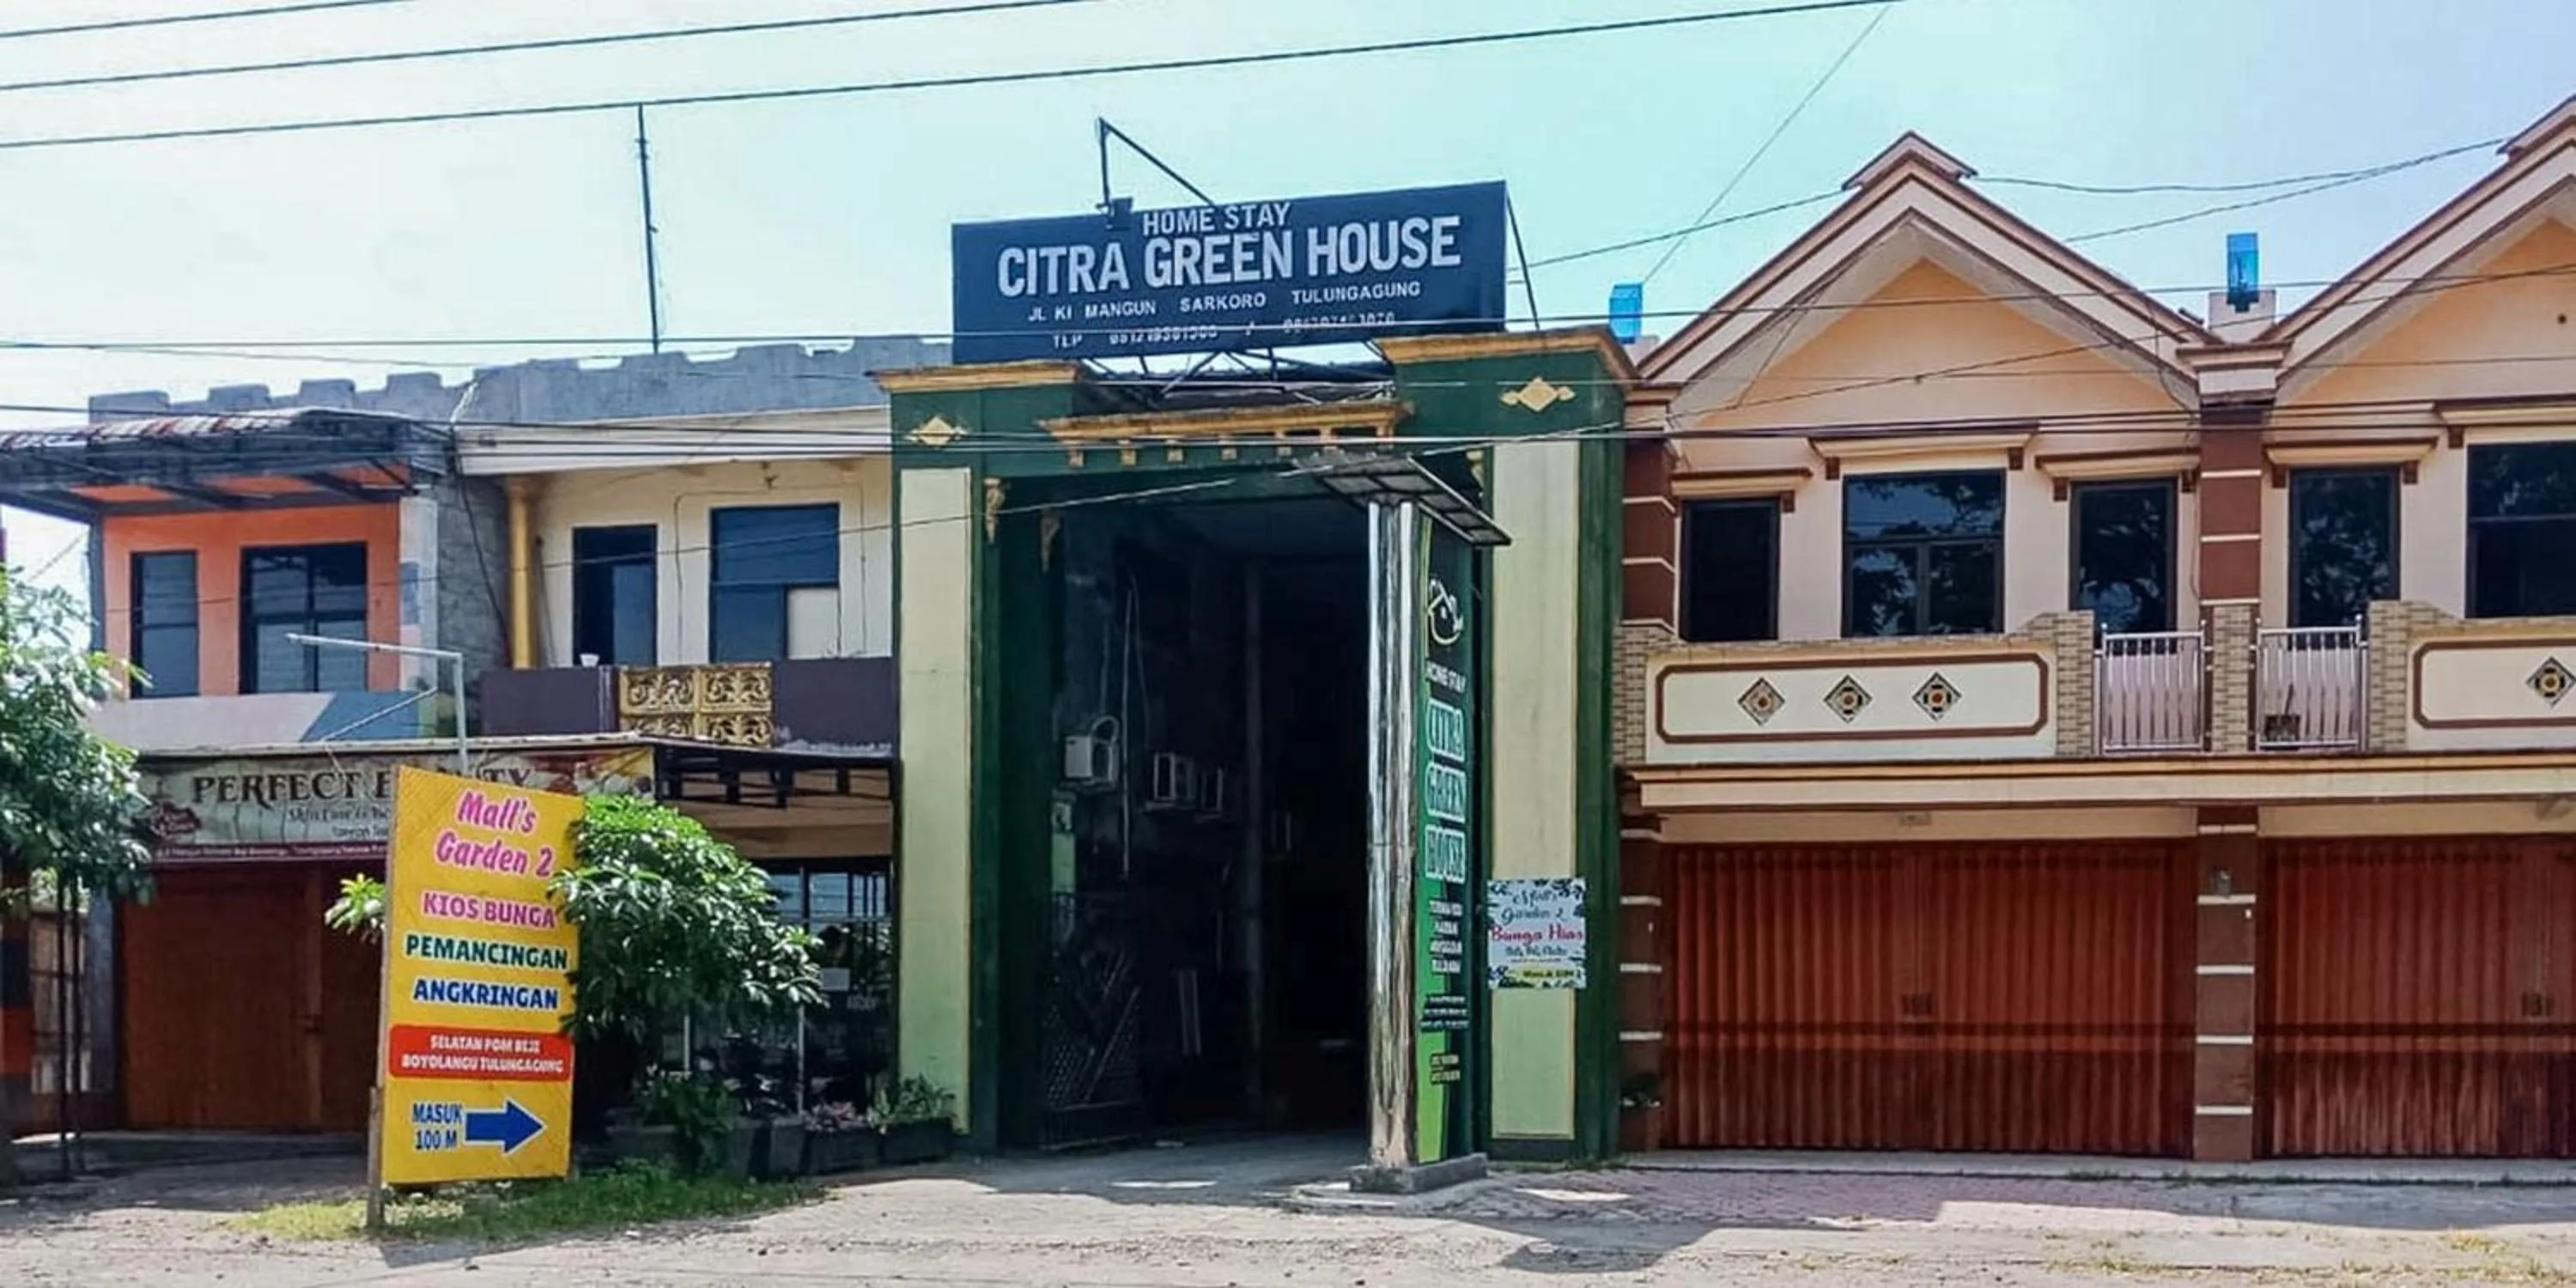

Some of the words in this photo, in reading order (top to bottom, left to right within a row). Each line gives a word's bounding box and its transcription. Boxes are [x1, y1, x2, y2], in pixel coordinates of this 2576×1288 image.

[1143, 208, 1215, 235] HOME
[1224, 202, 1292, 230] STAY
[998, 240, 1129, 296] CITRA
[1145, 230, 1291, 287] GREEN
[1307, 215, 1461, 276] HOUSE
[1054, 304, 1072, 320] KI
[1084, 301, 1157, 319] MANGUN
[1180, 292, 1267, 313] SARKORO
[1292, 281, 1421, 305] TULUNGAGUNG
[1426, 696, 1465, 762] CITRA
[191, 771, 361, 811] PERFECT
[1425, 761, 1467, 824] GREEN
[457, 791, 536, 833] Mall's
[436, 830, 528, 874] Garden
[535, 846, 554, 878] 2
[1425, 823, 1466, 884] HOUSE
[423, 892, 479, 919] KIOS
[484, 900, 556, 928] BUNGA
[405, 933, 568, 969] PEMANCINGAN
[1492, 924, 1543, 947] Bunga
[1549, 923, 1583, 940] Hias
[413, 978, 560, 1010] ANGKRINGAN
[430, 1034, 483, 1050] SELATAN
[483, 1036, 513, 1052] POM
[401, 1053, 477, 1071] BOYOLANGU
[480, 1055, 565, 1073] TULUNGAGUNG
[412, 1103, 463, 1124] MASUK
[415, 1129, 441, 1151] 100
[445, 1129, 459, 1150] M
